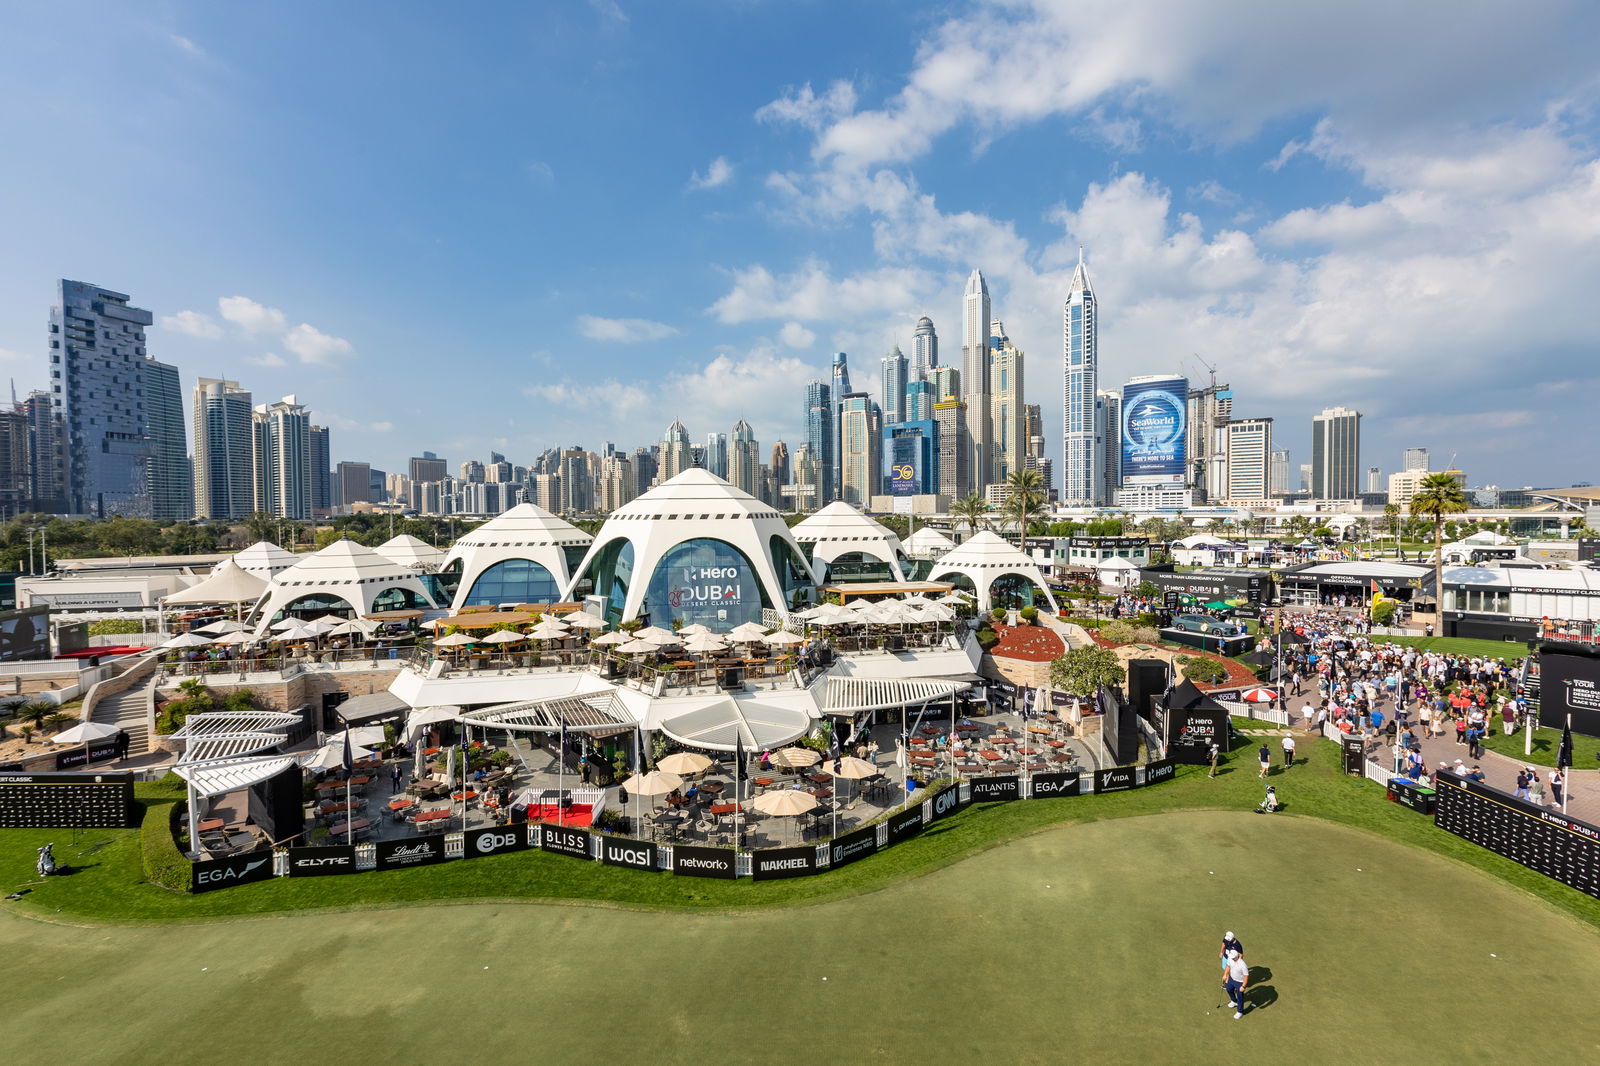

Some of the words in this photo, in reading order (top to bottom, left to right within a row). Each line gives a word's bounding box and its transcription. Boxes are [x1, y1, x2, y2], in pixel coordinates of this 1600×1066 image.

[1131, 416, 1174, 427] SeaWorld
[701, 567, 737, 578] Hero
[681, 585, 740, 600] DUBAI
[1155, 765, 1173, 777] Hero
[974, 782, 1016, 792] ATLANTIS
[1036, 781, 1058, 793] EGA
[936, 788, 956, 814] CNN
[1549, 815, 1568, 827] Hero
[1573, 823, 1599, 839] DUBAI
[546, 830, 584, 848] BLISS
[394, 844, 423, 856] Lindt
[609, 846, 650, 866] wasl
[680, 857, 722, 870] network
[760, 858, 809, 871] NAKHEEL
[198, 867, 237, 884] EGA
